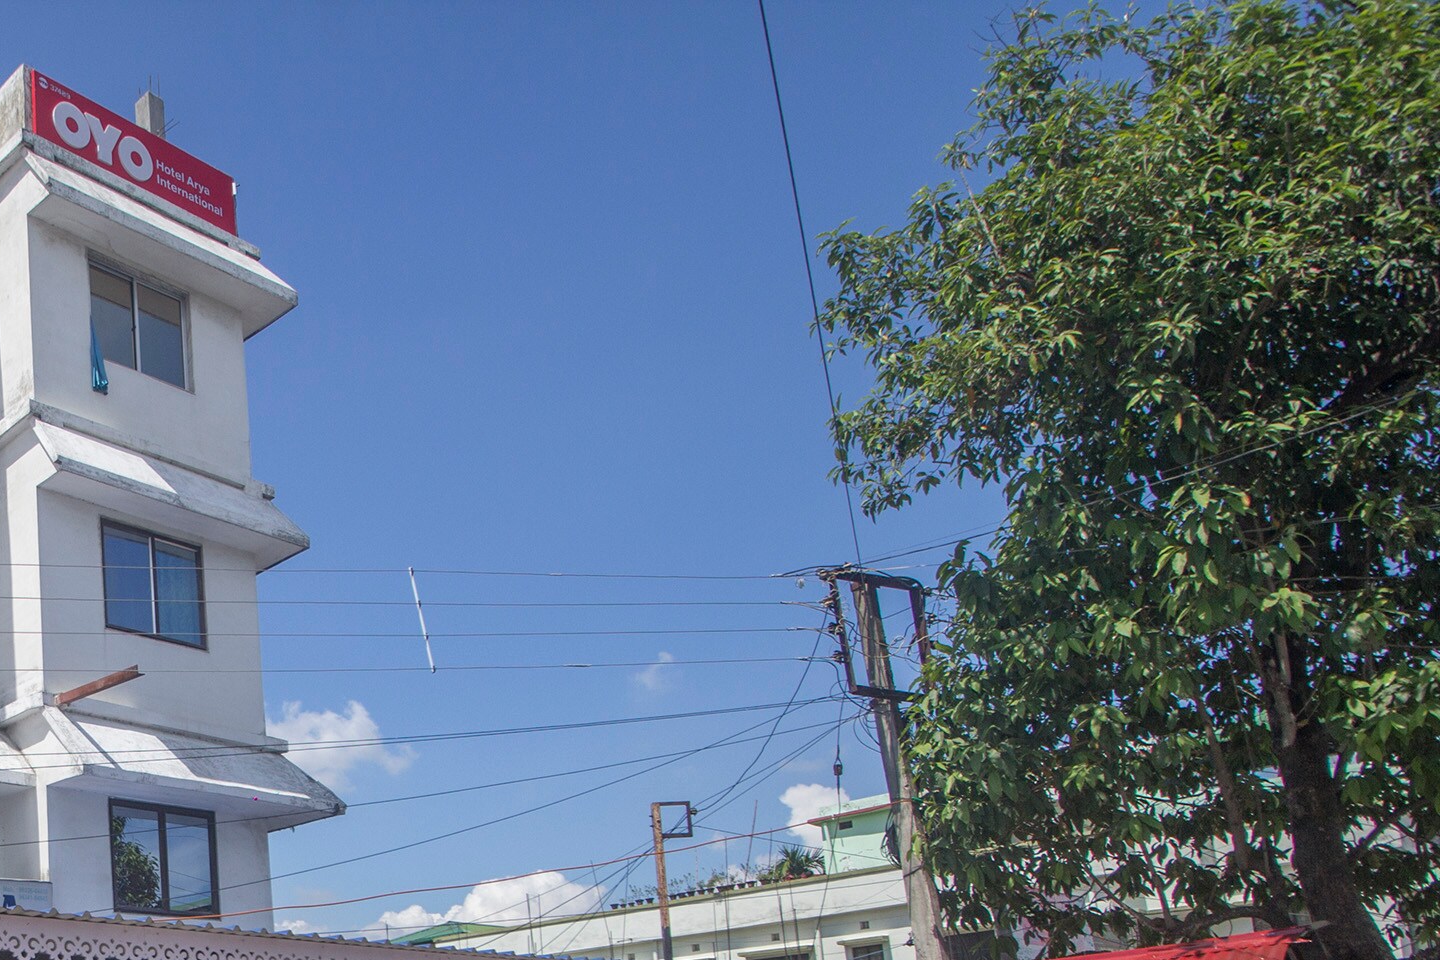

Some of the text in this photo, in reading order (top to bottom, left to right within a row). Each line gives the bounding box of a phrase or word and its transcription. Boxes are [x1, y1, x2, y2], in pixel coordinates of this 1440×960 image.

[52, 101, 153, 182] OYO
[156, 160, 210, 196] Hotel Arya
[157, 174, 223, 217] International
